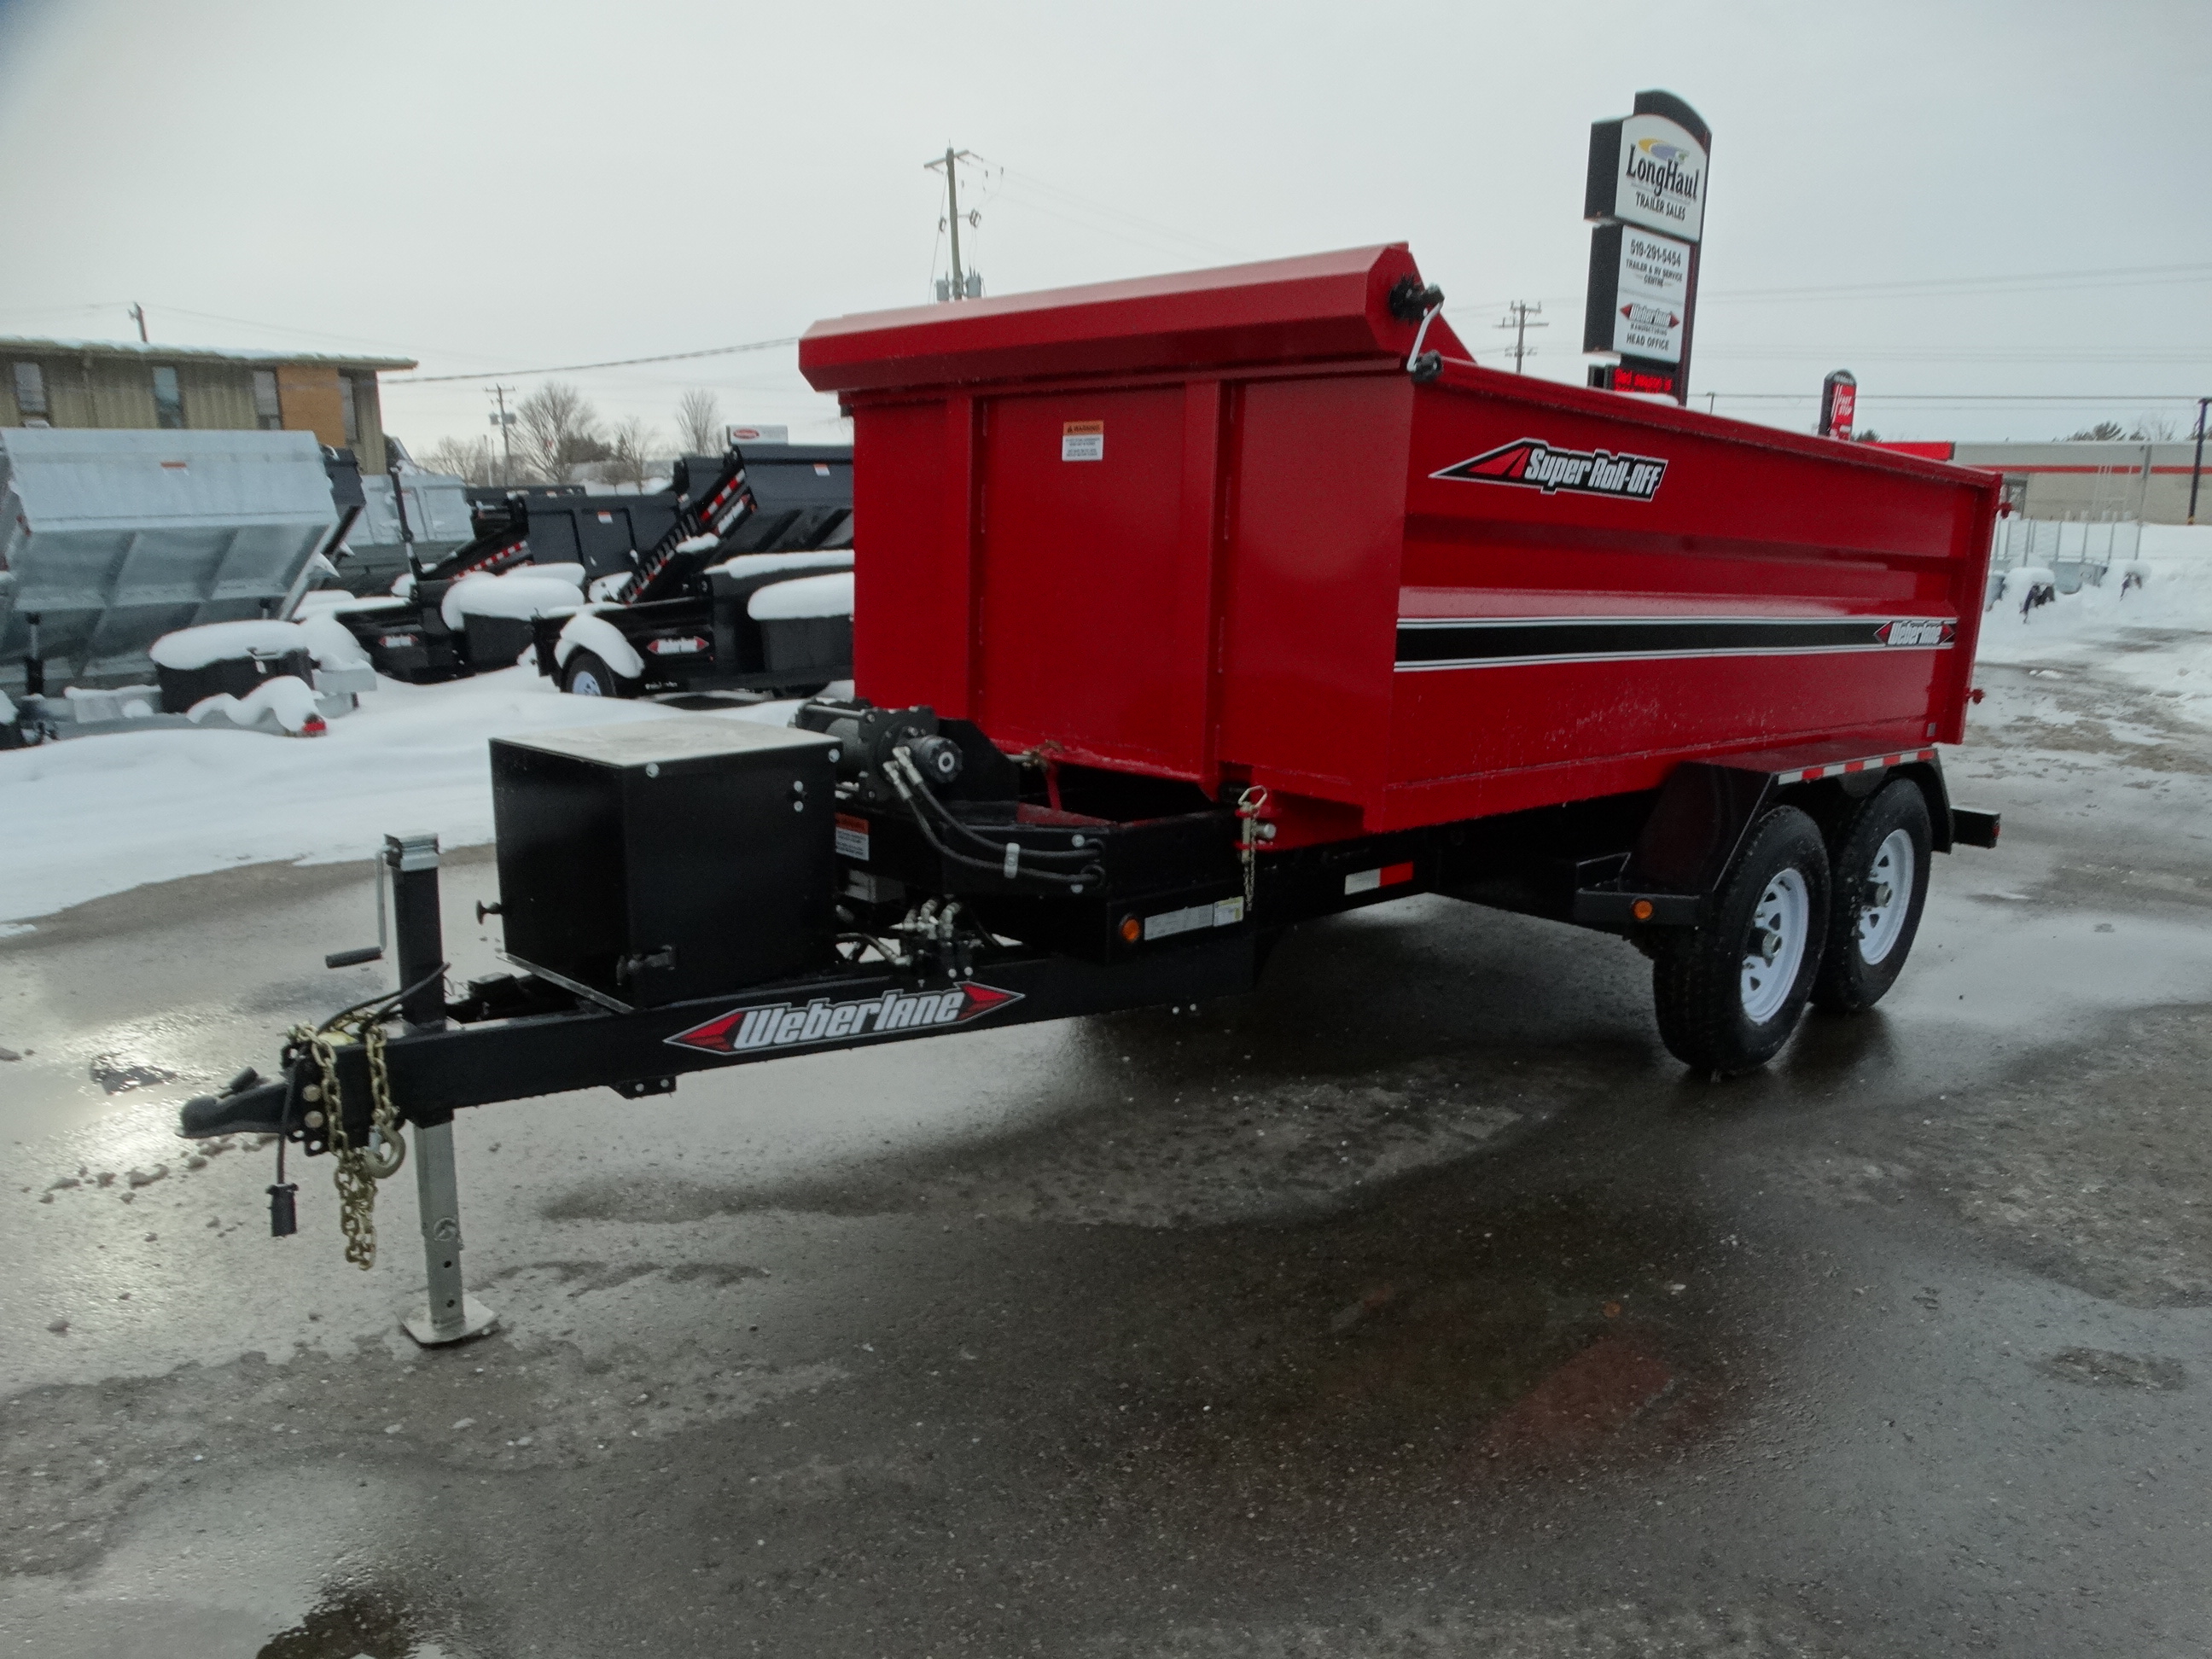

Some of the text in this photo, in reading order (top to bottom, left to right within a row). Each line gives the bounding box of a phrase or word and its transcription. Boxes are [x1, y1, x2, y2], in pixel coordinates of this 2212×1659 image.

[1626, 143, 1699, 201] LongHaul
[1636, 191, 1686, 221] TRAILER SALES
[1630, 239, 1681, 267] 519-291-5454
[1626, 259, 1648, 272] TRAILER
[1654, 266, 1662, 276] RV
[1662, 268, 1683, 282] SERVICE
[1644, 274, 1664, 288] CENTRE
[1627, 333, 1669, 351] HEAD OFFICE
[1524, 448, 1591, 487] Super
[734, 991, 966, 1050] Weberlane
